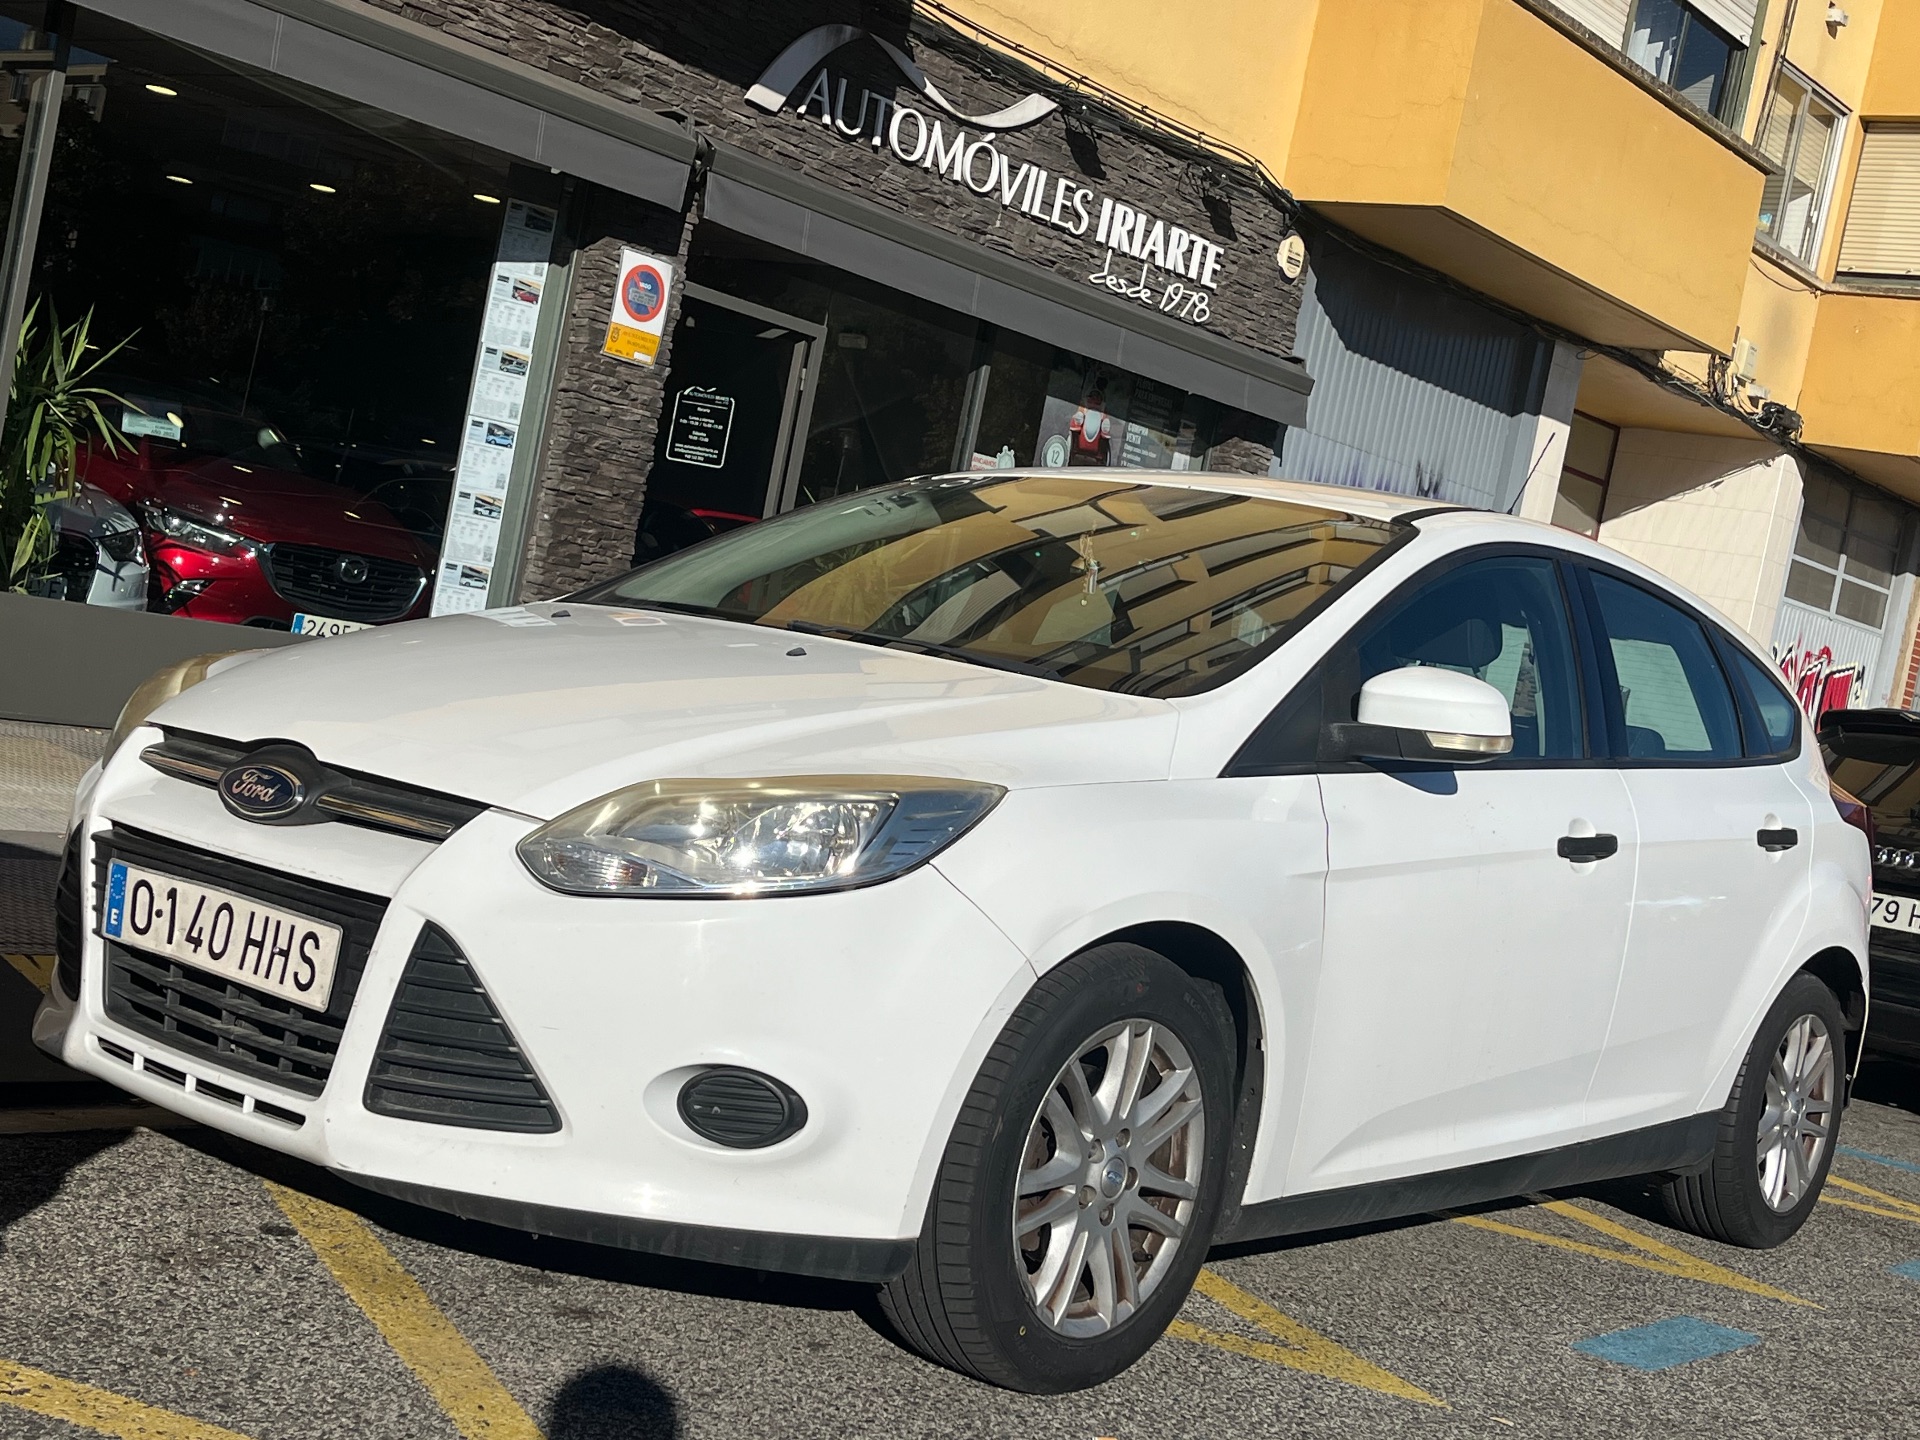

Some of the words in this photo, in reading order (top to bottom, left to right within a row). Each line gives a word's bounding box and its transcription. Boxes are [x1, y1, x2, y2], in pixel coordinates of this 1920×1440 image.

[797, 67, 1094, 236] AUTOMÓVILES
[1095, 198, 1226, 291] IRIARTE
[1088, 248, 1154, 306] desde
[1158, 283, 1212, 324] 1978
[1051, 449, 1061, 464] 12
[231, 768, 280, 803] Ford
[109, 908, 120, 926] E
[237, 910, 321, 993] HHS
